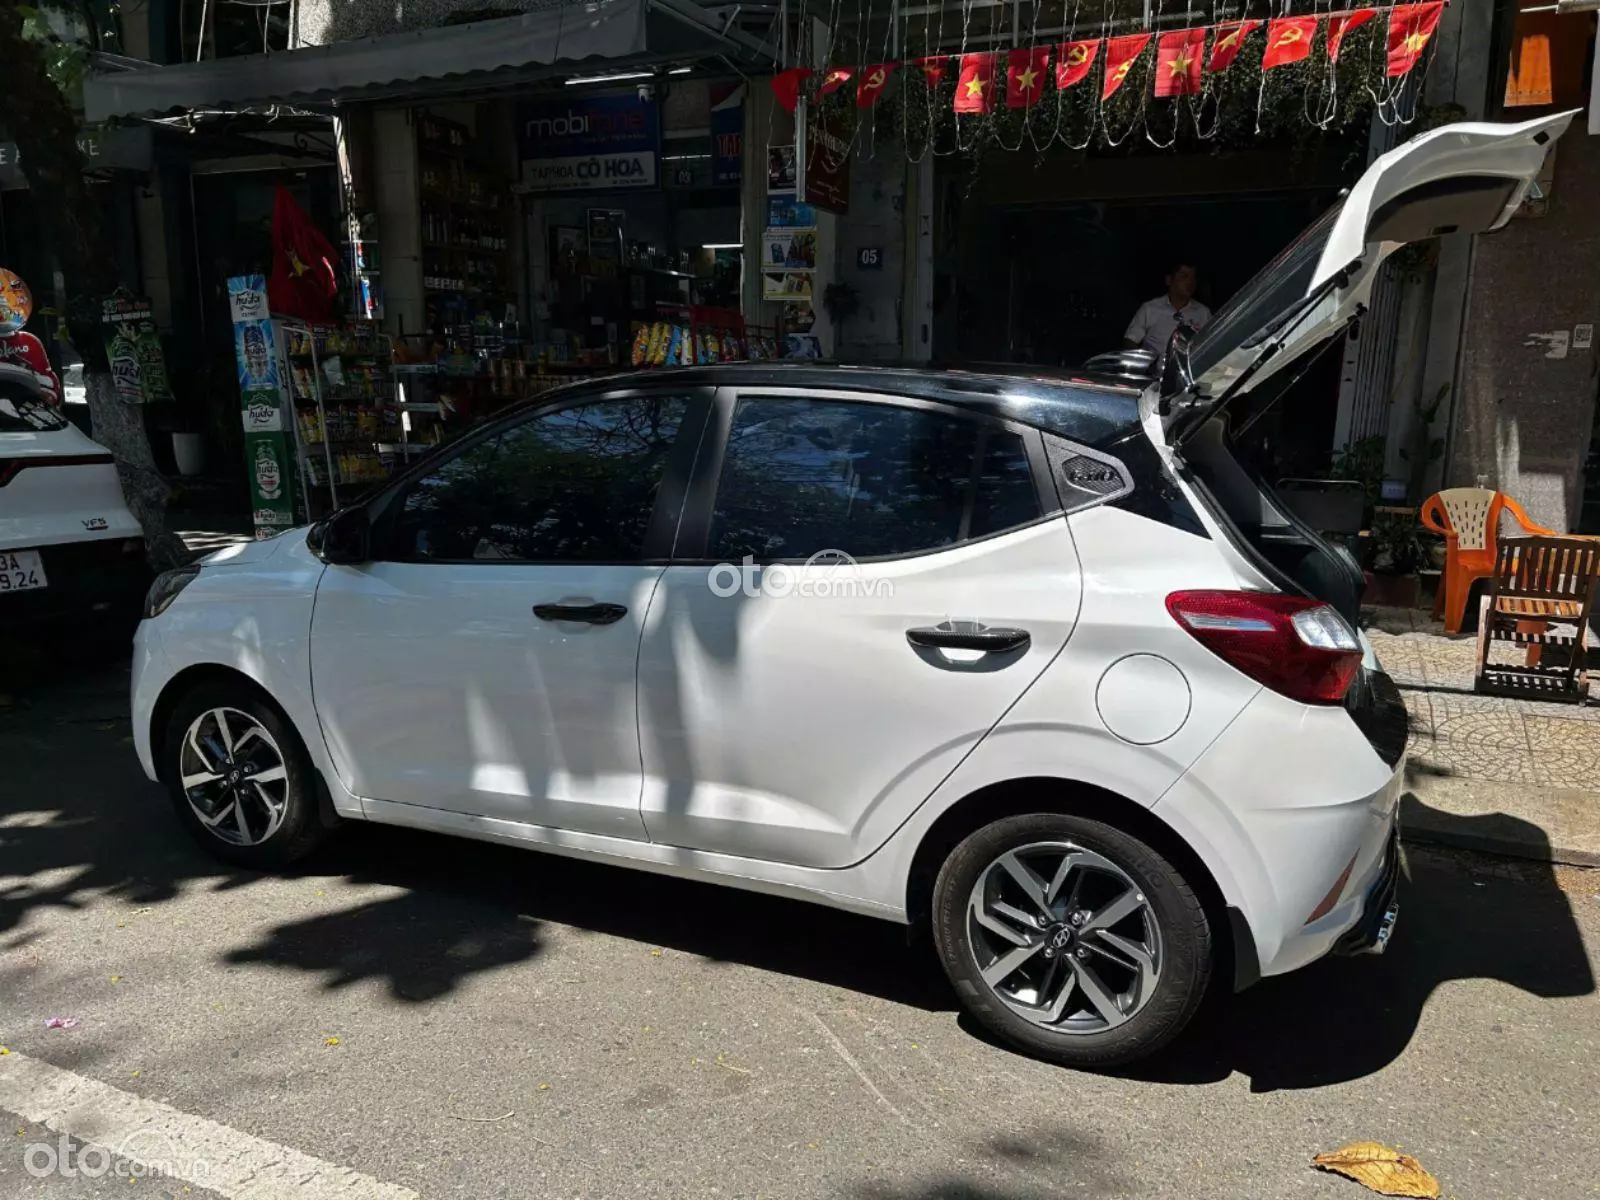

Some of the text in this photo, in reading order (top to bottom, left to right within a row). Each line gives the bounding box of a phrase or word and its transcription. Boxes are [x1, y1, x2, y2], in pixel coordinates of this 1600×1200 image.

[577, 156, 600, 179] CÔ
[605, 158, 644, 178] HOA
[861, 248, 878, 265] 05
[249, 406, 275, 419] huda
[0, 570, 39, 589] 9.24
